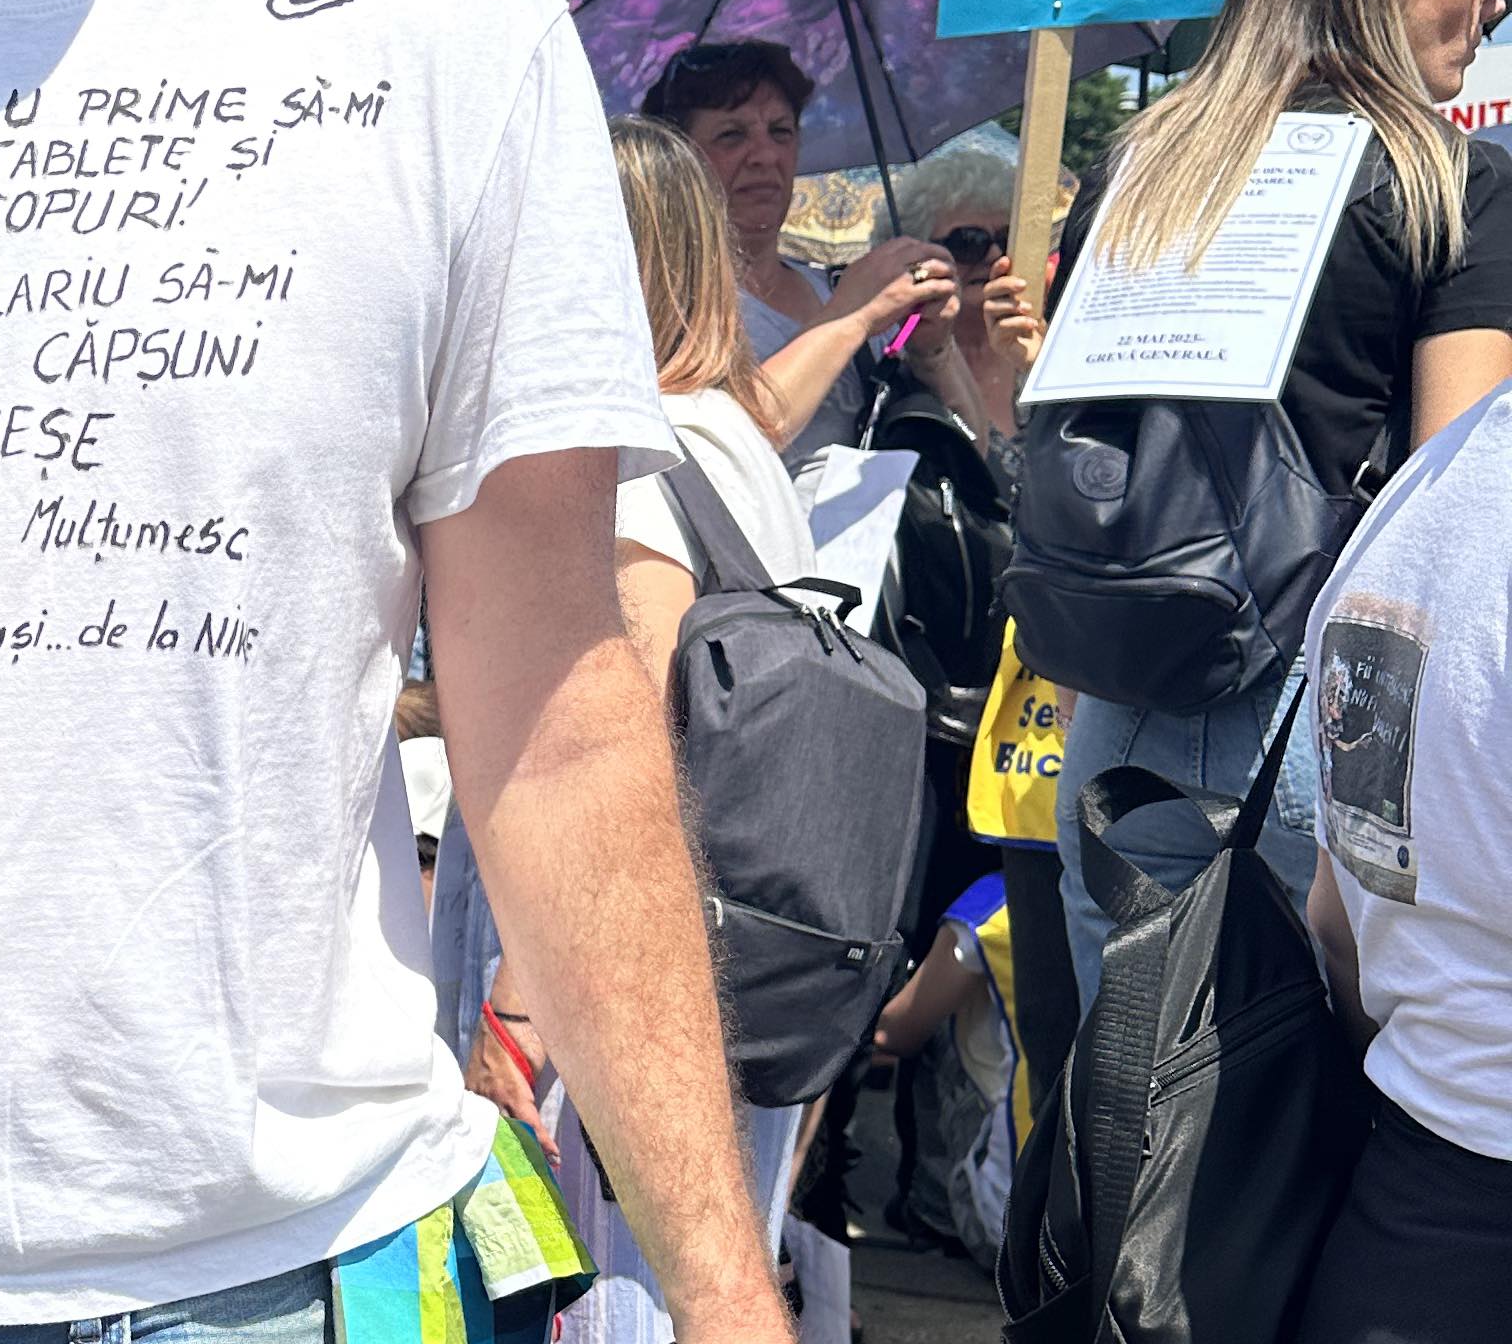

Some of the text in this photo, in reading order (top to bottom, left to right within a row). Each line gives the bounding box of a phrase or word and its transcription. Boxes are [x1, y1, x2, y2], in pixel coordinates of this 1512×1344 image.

[19, 494, 251, 565] Mulțumesc
[144, 599, 180, 653] la
[1018, 695, 1061, 728] Se
